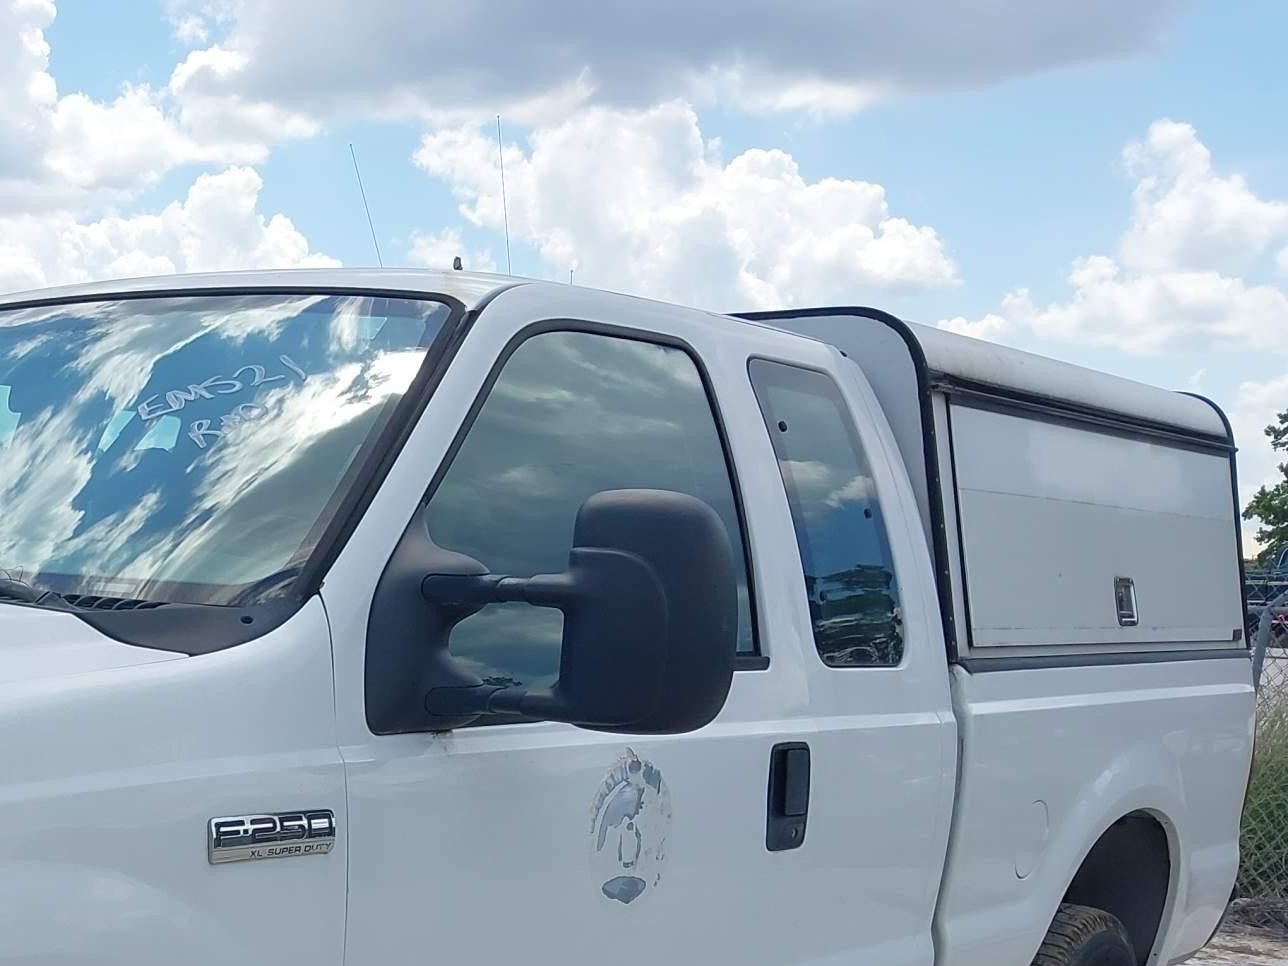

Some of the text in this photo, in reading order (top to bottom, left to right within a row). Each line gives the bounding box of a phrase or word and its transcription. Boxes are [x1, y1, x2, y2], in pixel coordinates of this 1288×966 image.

[250, 841, 332, 858] XL SUPER DUTY
